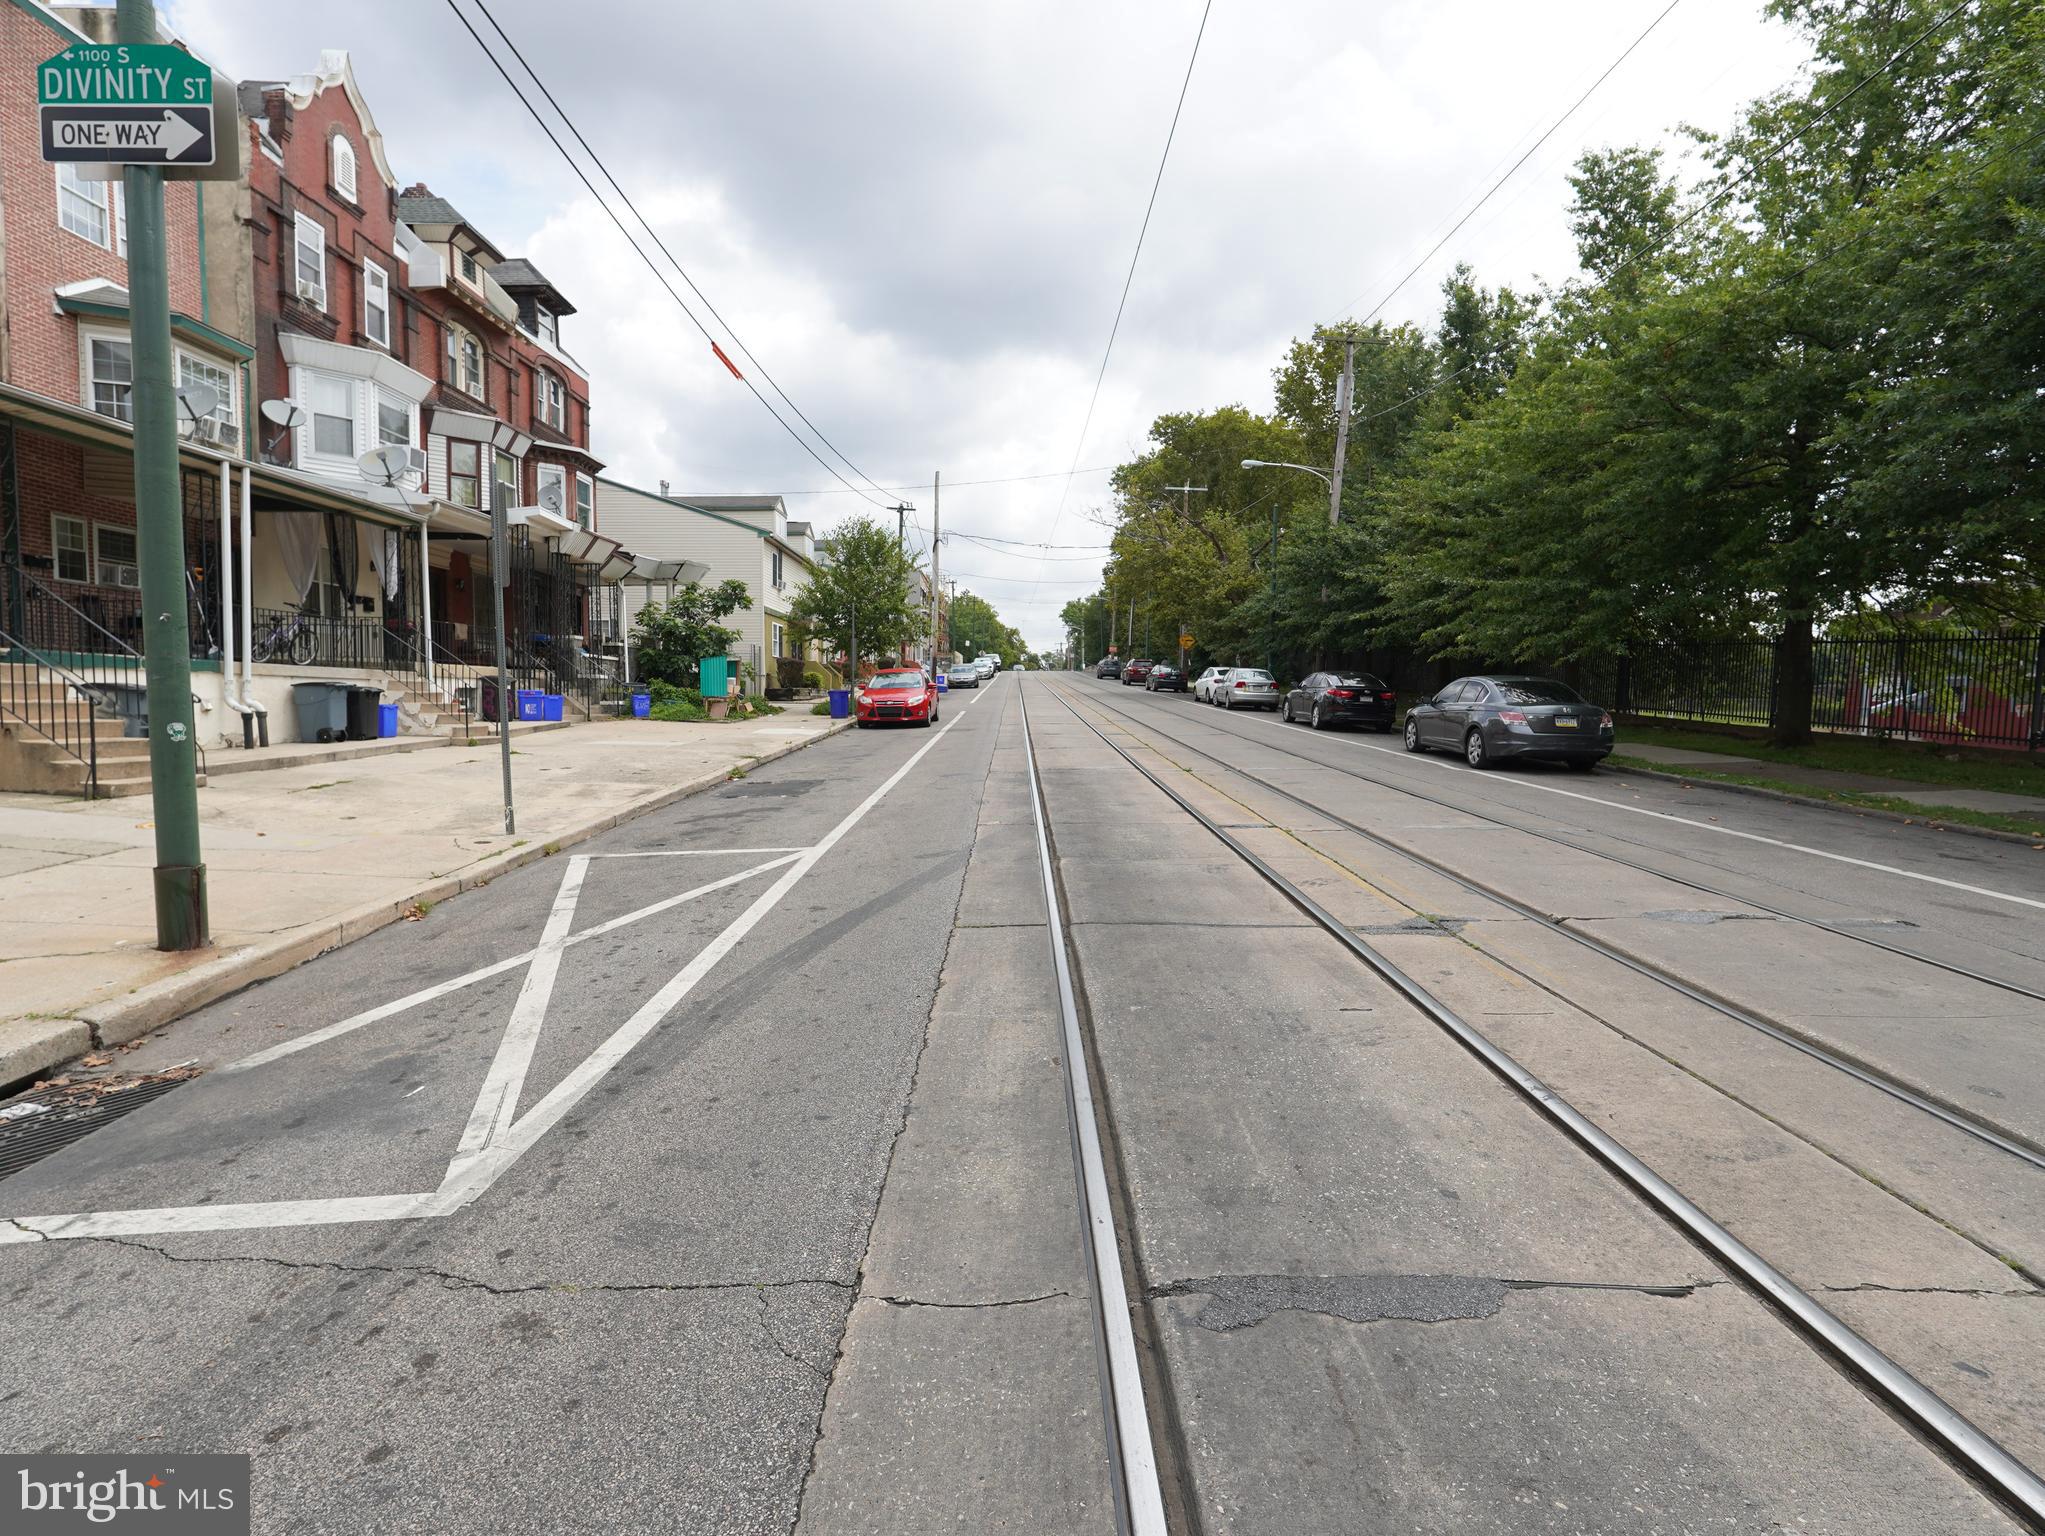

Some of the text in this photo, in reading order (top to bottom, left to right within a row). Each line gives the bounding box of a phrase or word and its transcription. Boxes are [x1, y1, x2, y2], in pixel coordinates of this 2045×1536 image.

[78, 47, 130, 64] 1100 S
[44, 67, 207, 100] DIVINITY ST
[61, 123, 162, 145] ONE WAY
